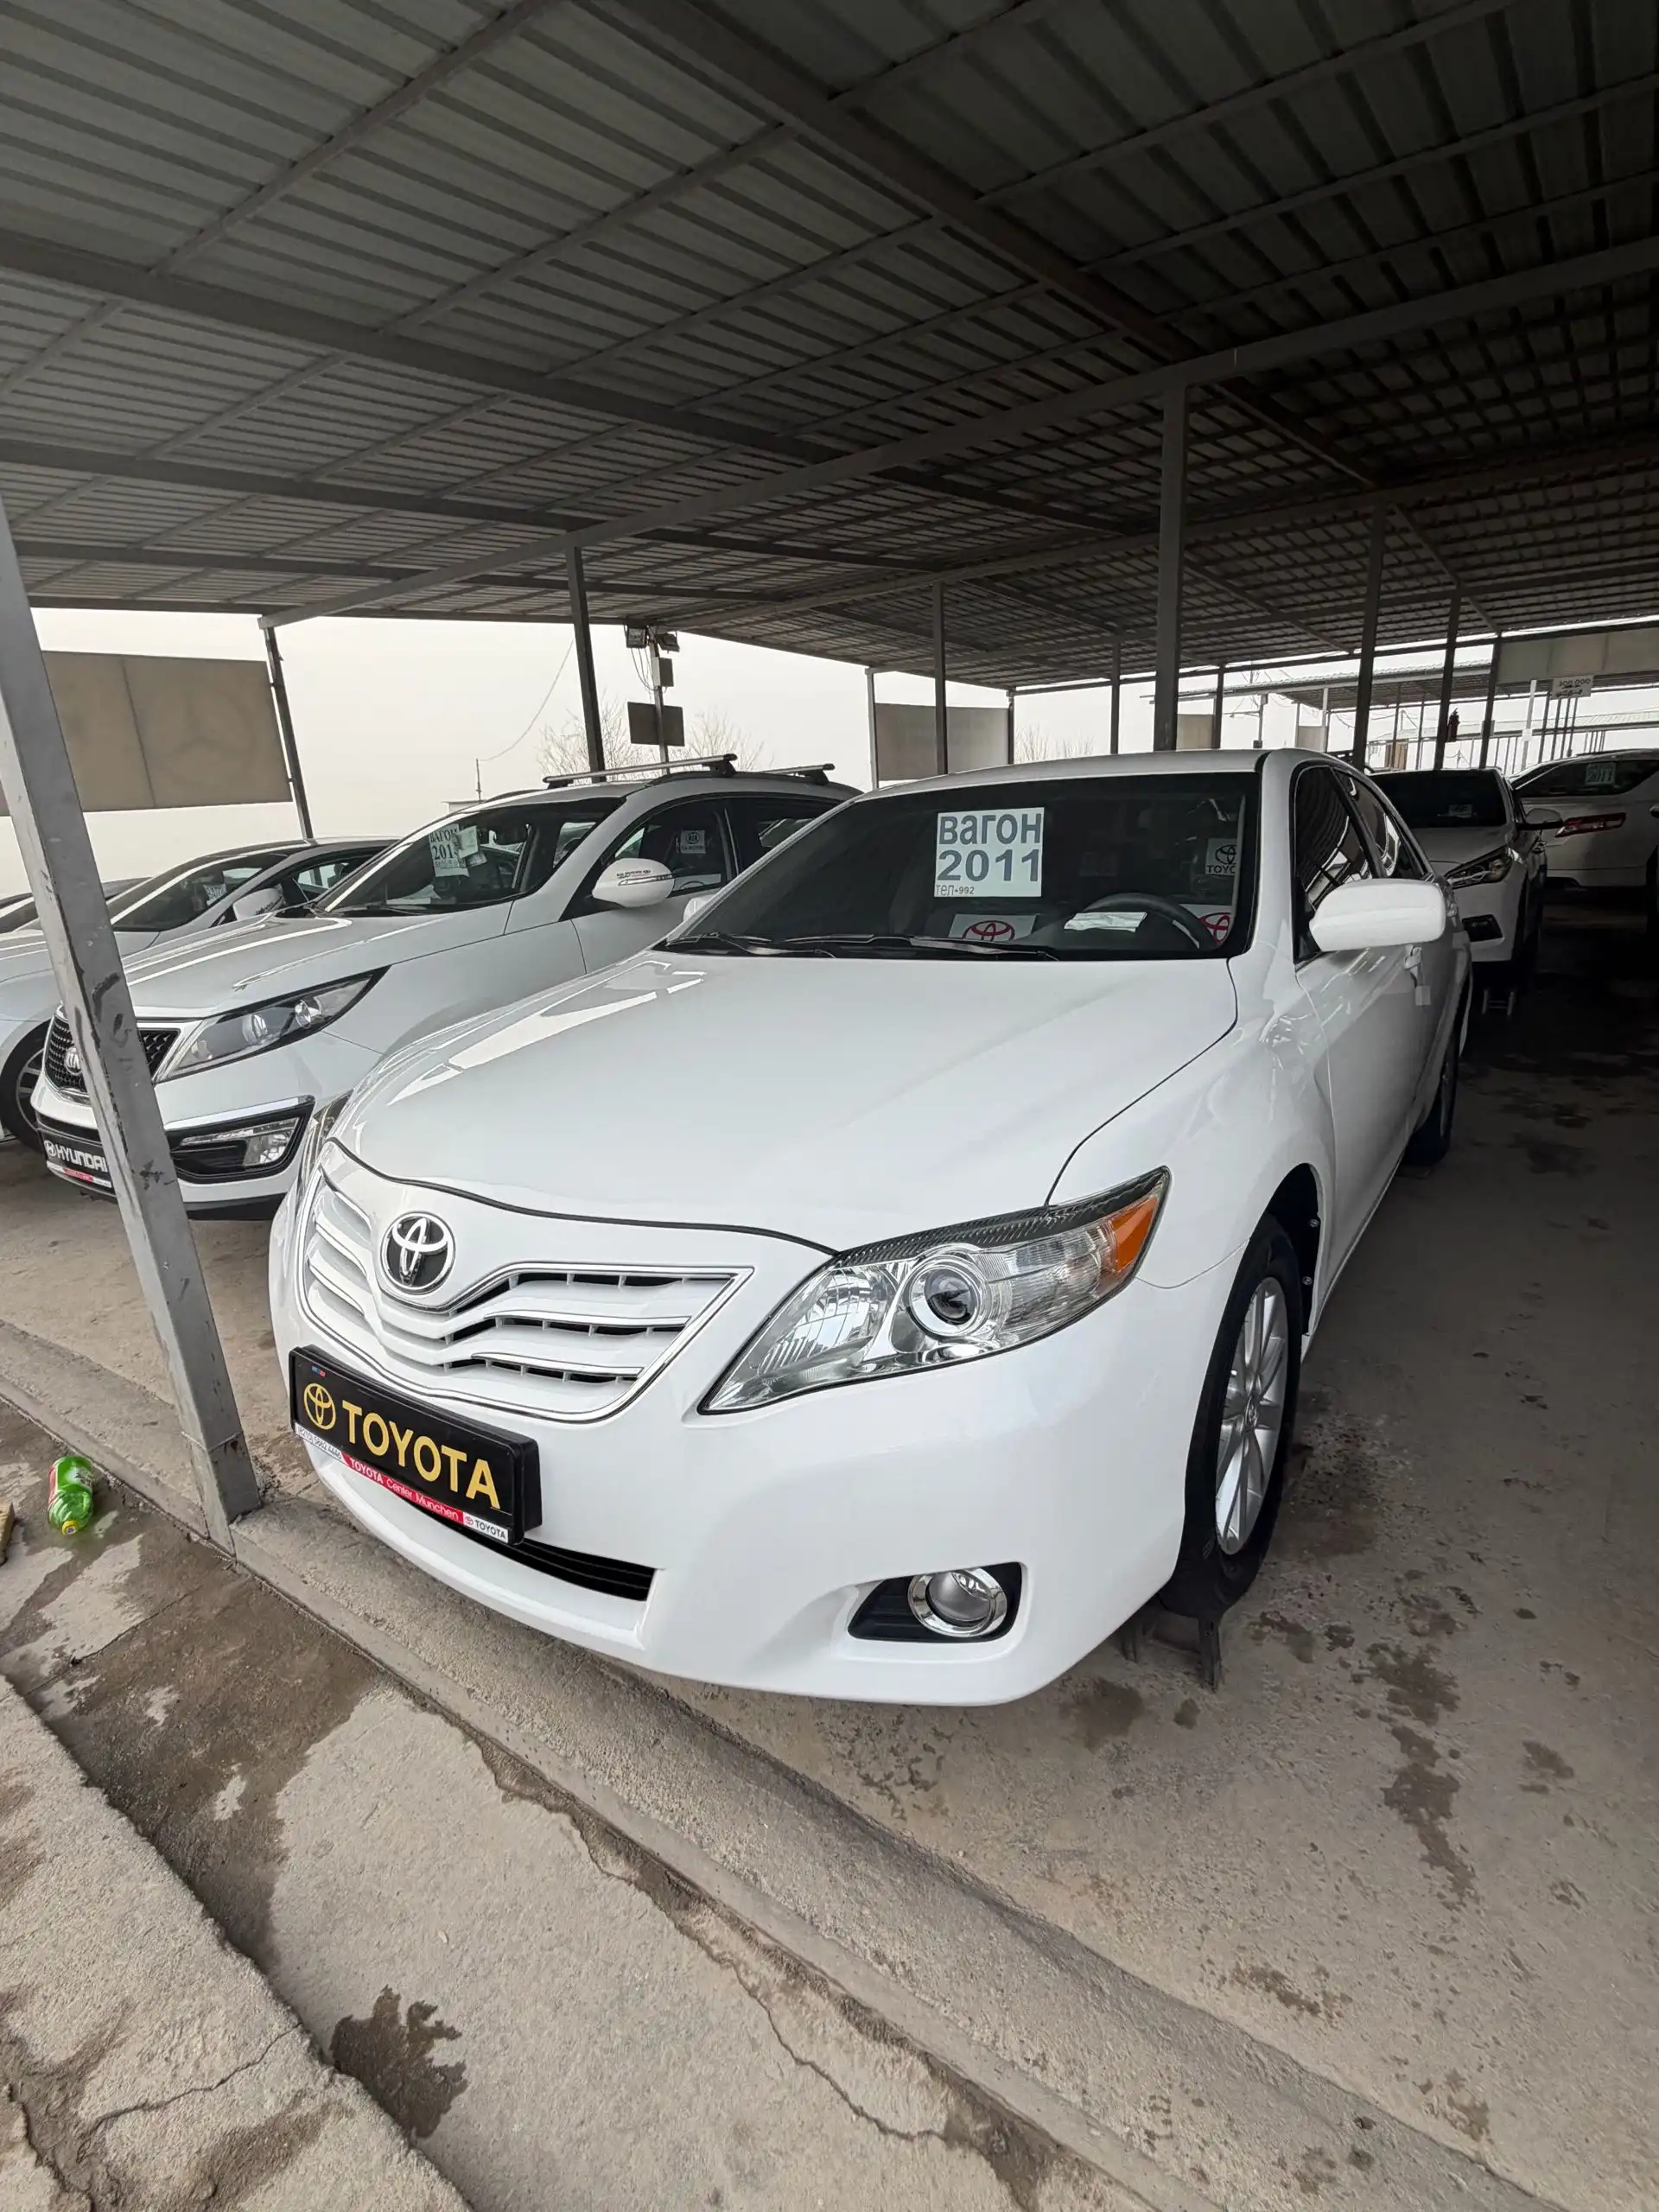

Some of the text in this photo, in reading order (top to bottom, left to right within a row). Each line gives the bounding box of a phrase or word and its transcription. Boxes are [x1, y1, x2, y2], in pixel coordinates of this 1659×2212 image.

[431, 844, 458, 861] 201
[937, 849, 1039, 882] 2011
[54, 1143, 108, 1173] HYUNDAI
[341, 1399, 501, 1510] TOYOTA
[349, 1457, 384, 1484] TOYOTA
[386, 1478, 414, 1500] Center
[474, 1518, 507, 1541] TOYOTA
